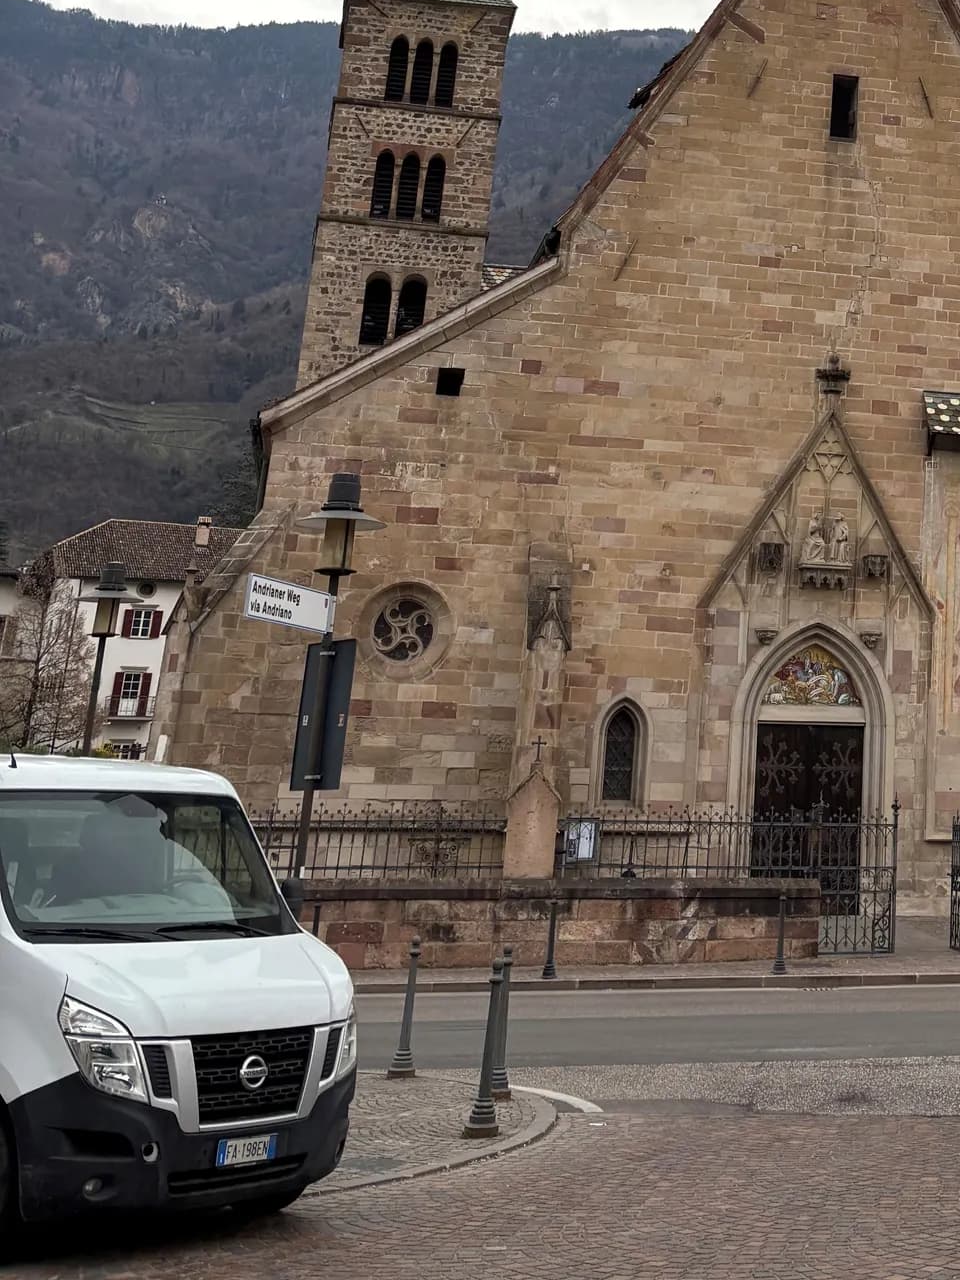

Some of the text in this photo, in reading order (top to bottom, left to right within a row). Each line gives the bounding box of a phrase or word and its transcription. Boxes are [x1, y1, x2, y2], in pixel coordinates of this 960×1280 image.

[252, 580, 301, 606] Andrianer Weg
[250, 599, 293, 620] via Andriano
